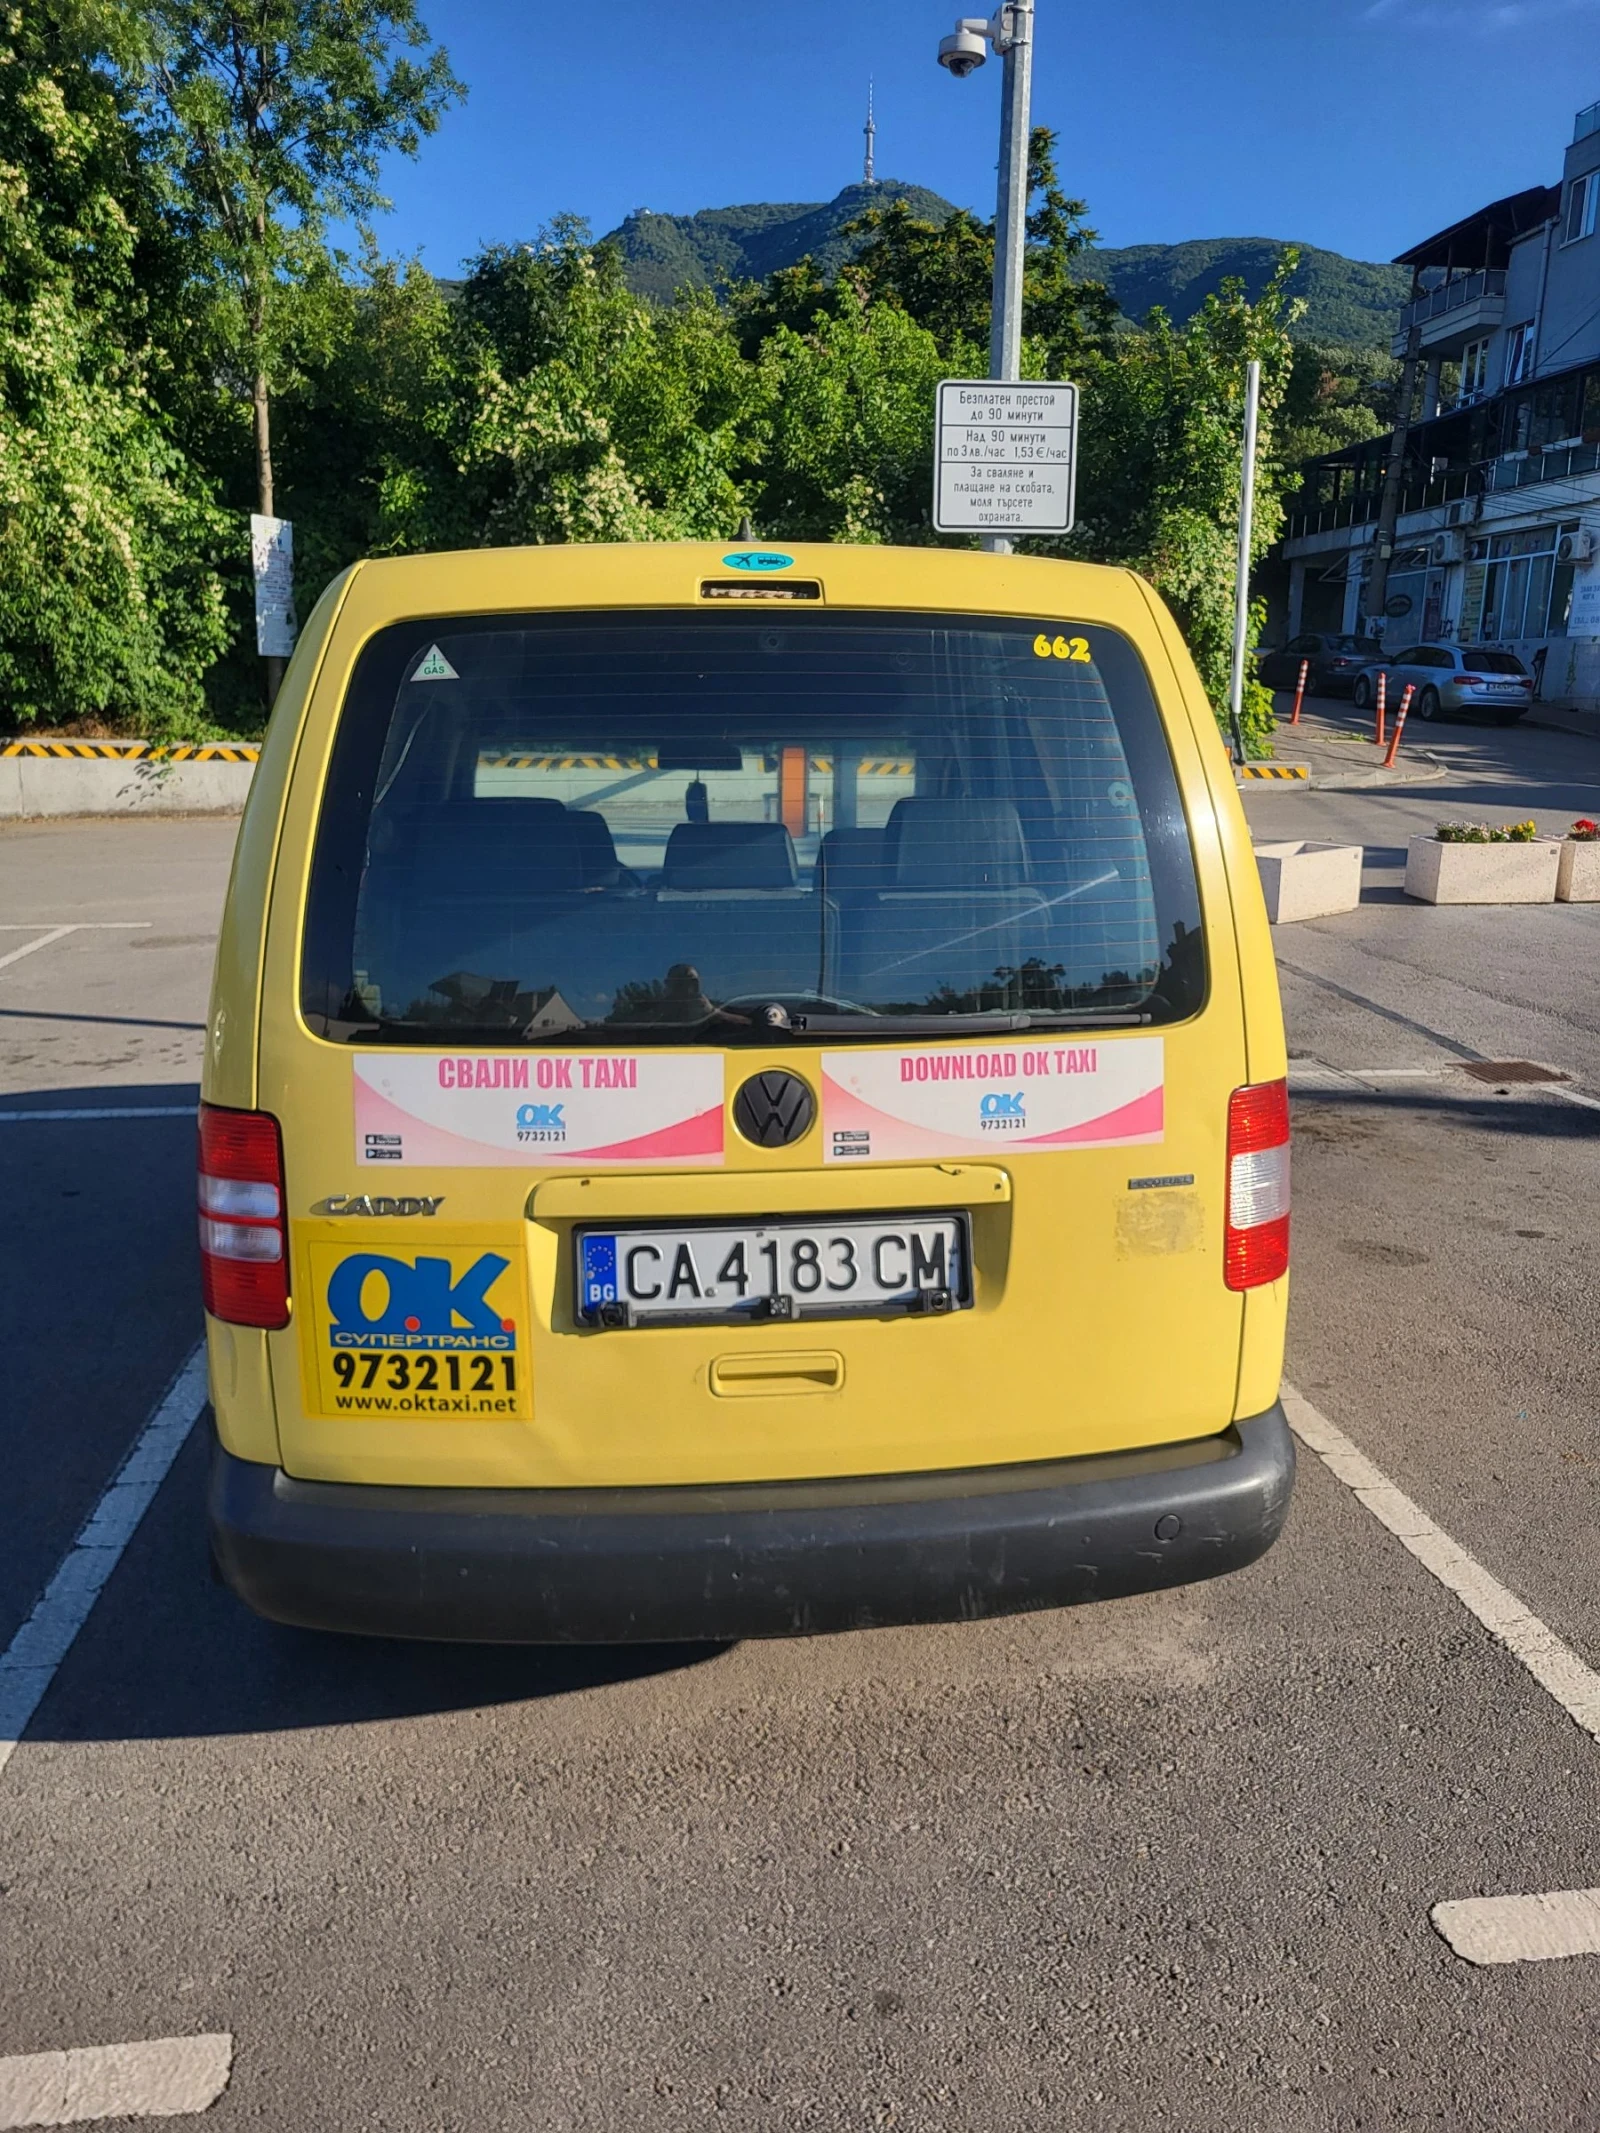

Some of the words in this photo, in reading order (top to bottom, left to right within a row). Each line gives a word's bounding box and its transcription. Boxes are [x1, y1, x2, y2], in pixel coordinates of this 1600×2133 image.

[959, 391, 1011, 406] Безплатен
[1016, 394, 1055, 408] престой
[970, 410, 983, 421] до
[988, 408, 1002, 420] 90
[1007, 411, 1044, 423] минути
[966, 430, 986, 443] Над
[991, 430, 1005, 442] 90
[1010, 433, 1046, 445] минути
[947, 447, 959, 457] по
[970, 466, 982, 478] За
[986, 469, 1024, 478] сваляне
[1028, 469, 1034, 478] и
[954, 483, 995, 493] плащане
[999, 483, 1011, 493] на
[970, 498, 992, 507] моля
[997, 498, 1033, 510] търсете
[978, 513, 1023, 524] охраната.
[1033, 634, 1091, 663] 662
[423, 666, 445, 675] GAS
[900, 1053, 1017, 1082] DOWNLOAD
[1022, 1051, 1050, 1076] OK
[1053, 1048, 1097, 1074] TAXI
[438, 1058, 529, 1089] СВАЛИ
[536, 1058, 573, 1089] OK
[578, 1058, 637, 1089] TAXI
[980, 1118, 1026, 1131] 9732121
[517, 1131, 566, 1142] 9732121
[322, 1193, 446, 1217] CADDY
[626, 1242, 702, 1300] CA
[718, 1237, 858, 1297] 4183
[873, 1232, 946, 1290] CM
[589, 1283, 615, 1301] BG
[334, 1332, 510, 1349] СУПЕРТРАНС
[333, 1352, 516, 1391] 9732121
[335, 1393, 517, 1413] www.oktaxi.net
